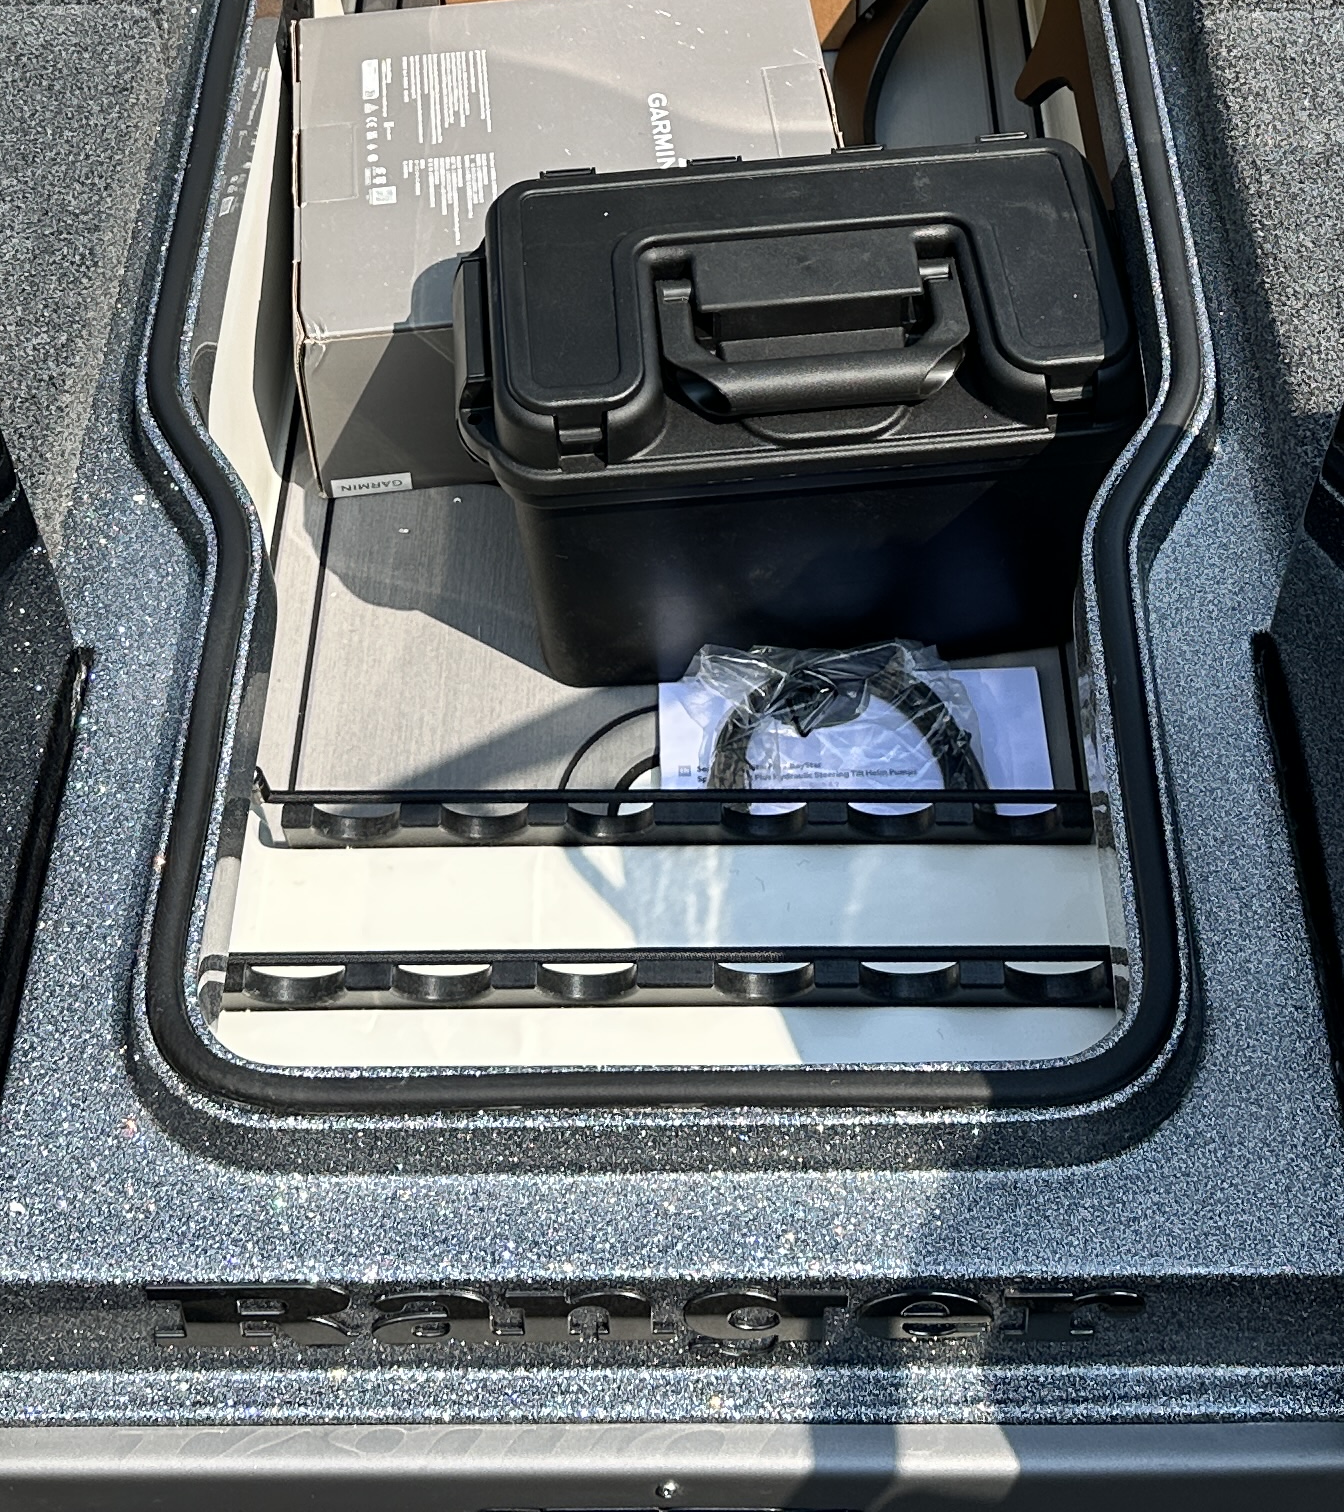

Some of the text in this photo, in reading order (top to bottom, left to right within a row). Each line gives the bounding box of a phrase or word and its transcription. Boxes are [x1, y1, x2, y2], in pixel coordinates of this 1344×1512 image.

[647, 92, 676, 169] GARMIN
[340, 479, 403, 492] GARMIN
[814, 770, 850, 779] Steering
[145, 1284, 1146, 1358] Ranger
